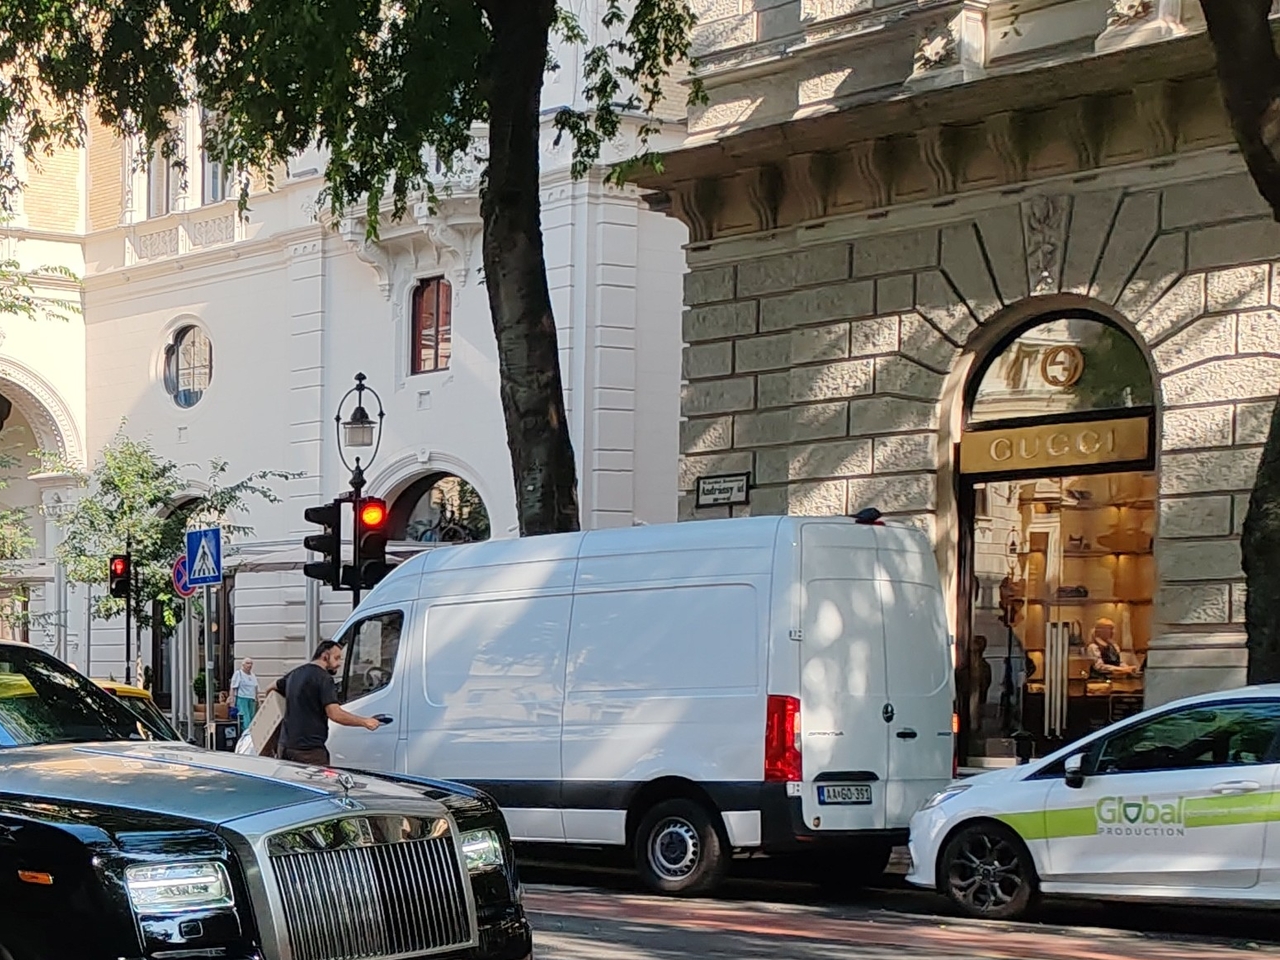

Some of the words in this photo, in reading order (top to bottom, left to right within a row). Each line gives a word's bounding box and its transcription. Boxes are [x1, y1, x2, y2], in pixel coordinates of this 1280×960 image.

[990, 428, 1115, 462] GUCCI
[1096, 796, 1183, 824] Global
[1098, 827, 1185, 836] PRODUCTION
